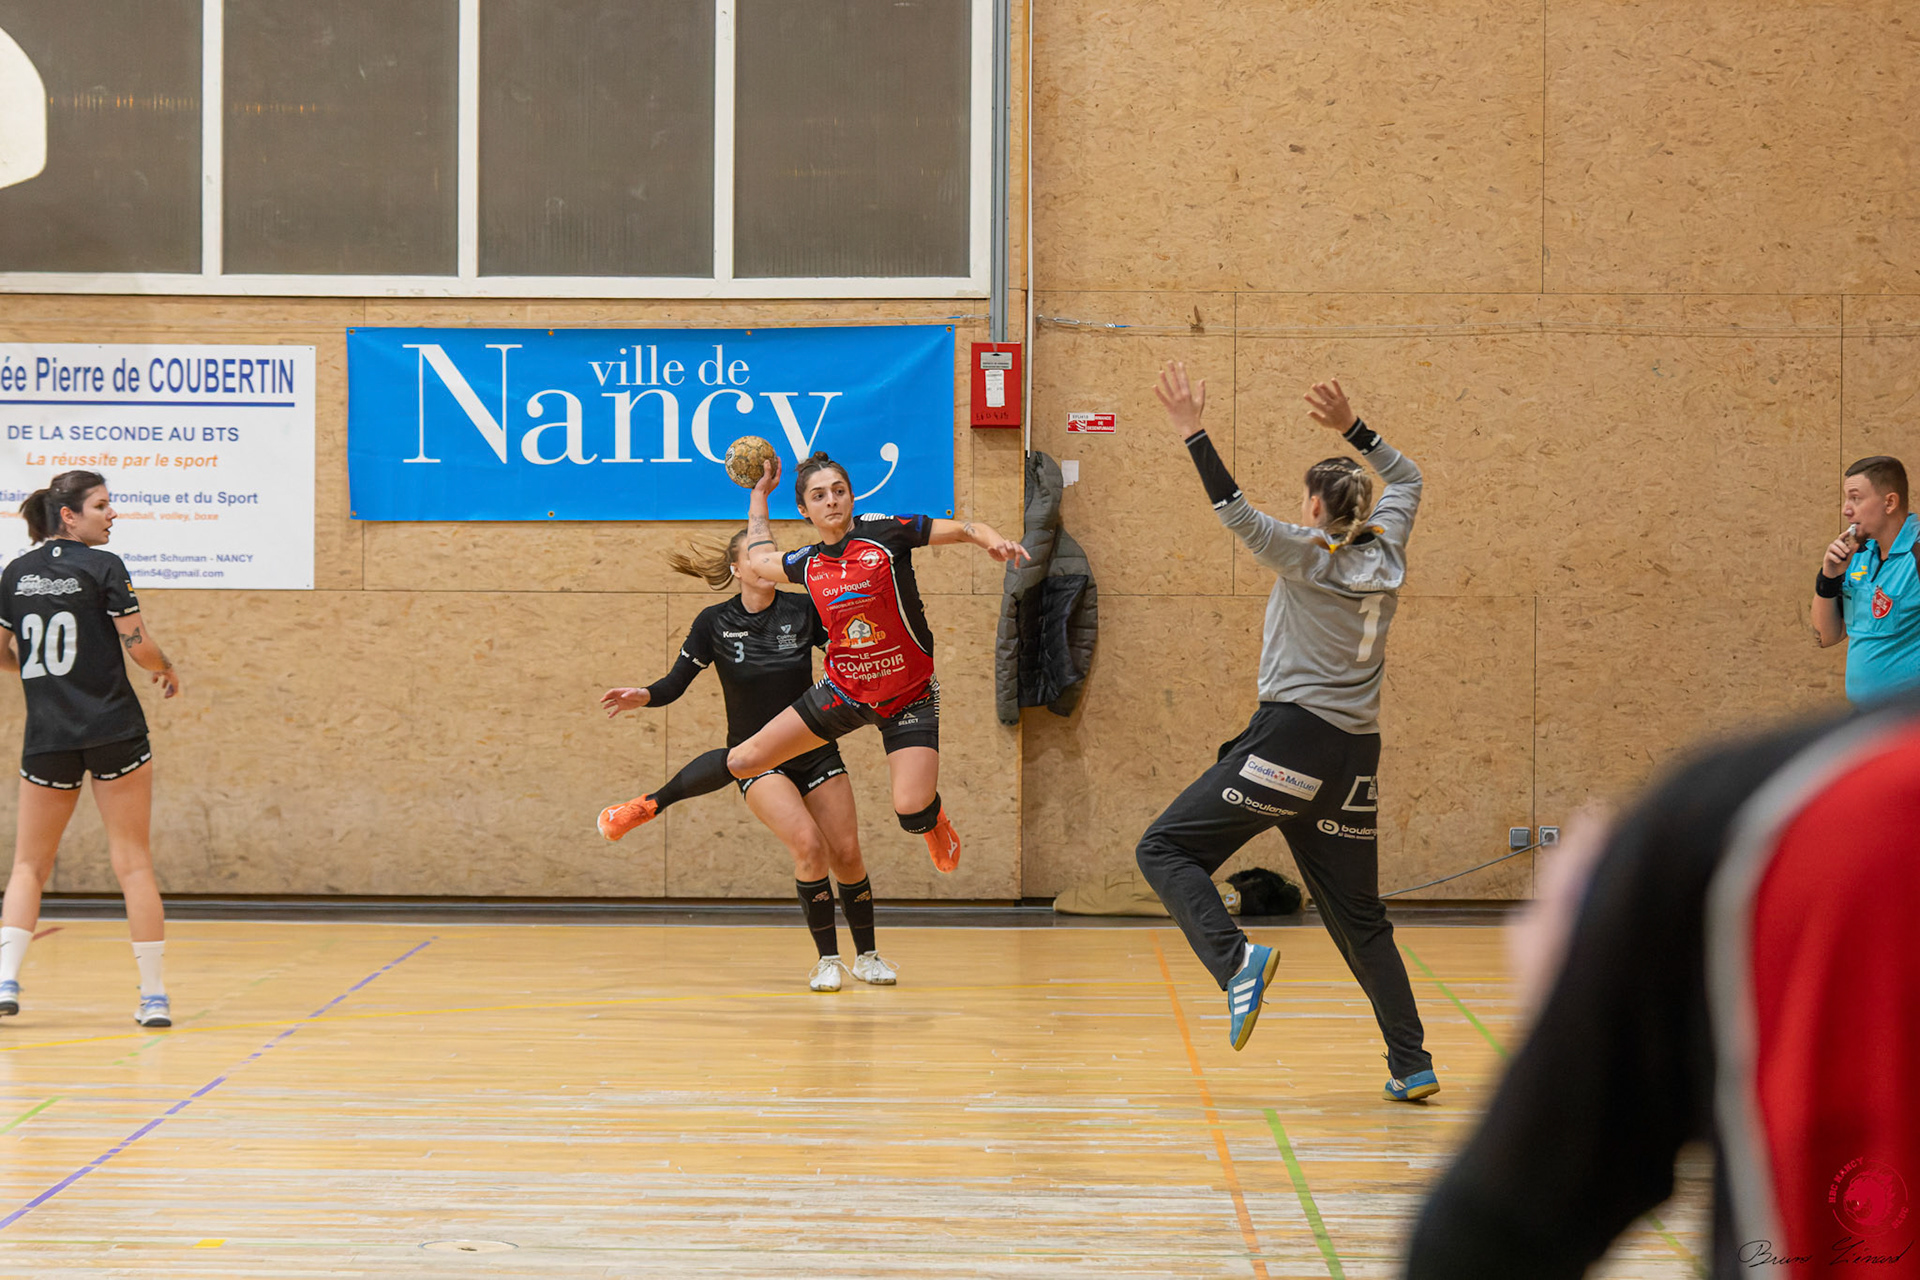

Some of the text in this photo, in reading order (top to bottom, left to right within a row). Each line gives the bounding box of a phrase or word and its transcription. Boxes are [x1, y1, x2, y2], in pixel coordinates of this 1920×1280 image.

[588, 345, 750, 386] ville de
[36, 357, 104, 392] Pierre
[113, 357, 140, 393] de
[149, 358, 295, 394] COUBERTIN
[8, 425, 240, 442] DE LA SECONDE AU BTS
[26, 452, 219, 469] La réussite par le sport
[0, 490, 259, 506] tiair tronique et du Sport
[117, 512, 156, 521] andball,
[194, 512, 219, 521] boxe
[124, 553, 157, 563] Robert
[160, 554, 207, 563] Schuman
[216, 554, 254, 563] NANCY
[128, 569, 224, 580] ertin54@gmail.com
[822, 579, 872, 597] Guy Hoquet
[722, 630, 749, 639] Kempa
[1356, 594, 1383, 662] 1
[21, 611, 77, 680] 20
[733, 641, 745, 663] 3
[837, 653, 905, 673] COMPTOIR
[859, 652, 871, 660] LE
[852, 668, 892, 682] Cmpanile
[1247, 760, 1275, 778] Crédit
[1285, 775, 1318, 793] Mutuel
[1244, 797, 1298, 817] boulanger
